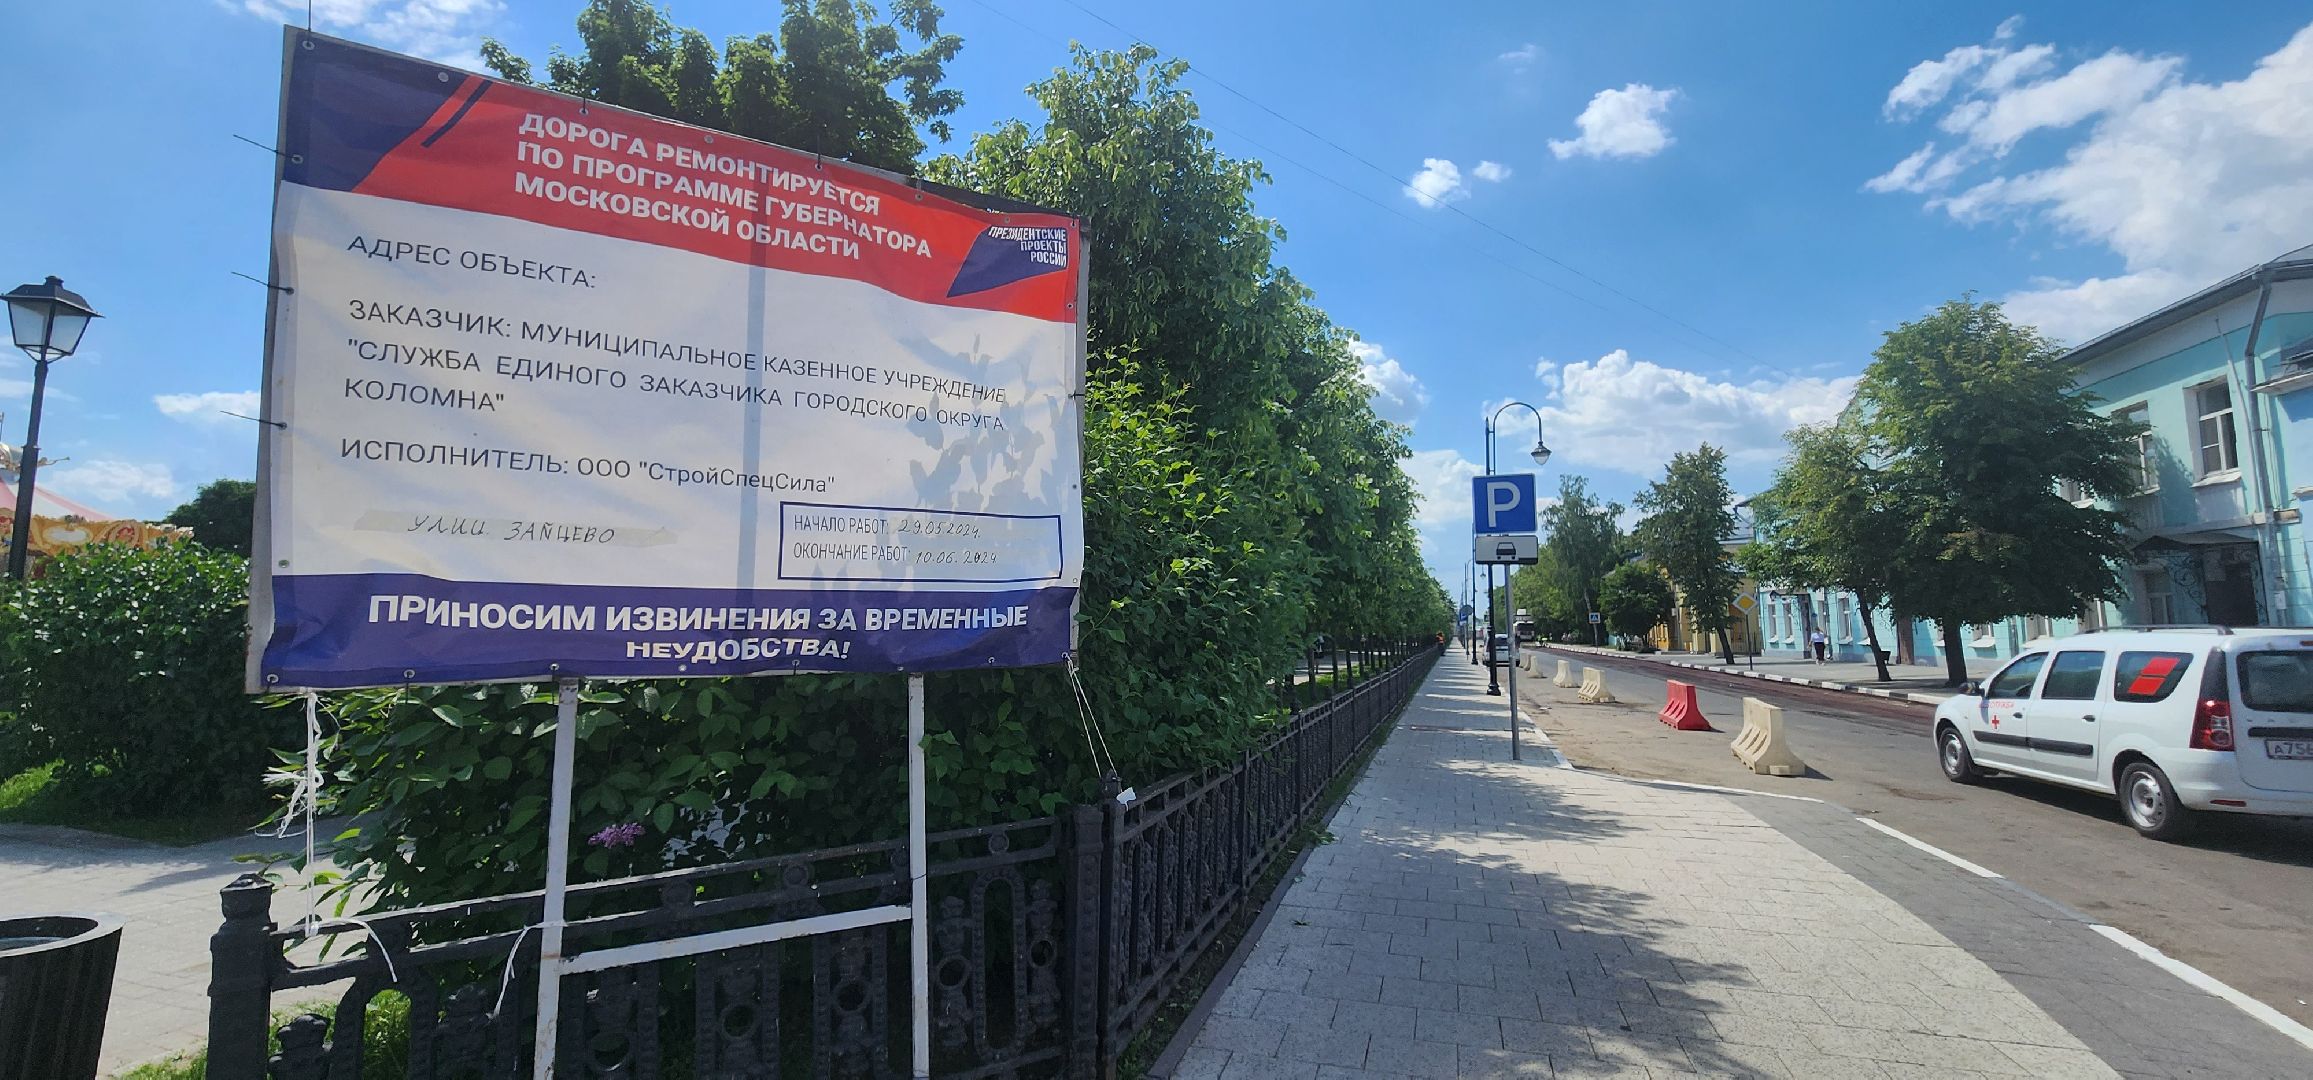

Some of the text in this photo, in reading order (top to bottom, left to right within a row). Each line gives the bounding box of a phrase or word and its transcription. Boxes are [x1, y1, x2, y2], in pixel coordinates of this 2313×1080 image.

[518, 112, 881, 216] ДОРОГА РЕМОНТИРУЕТСЯ
[514, 171, 860, 261] МОСКОВСКОЙ ОБЛАСТИ
[517, 140, 933, 259] ПО ПРОГРАММЕ ГУБЕРНАТОРА
[987, 225, 1067, 243] ПРЕЗИДЕНТСКИЕ
[1020, 240, 1067, 255] ПРОЕКТЫ
[347, 235, 597, 290] АДРЕС ОБЪЕКТА:
[1030, 251, 1067, 268] РОССИИ
[349, 299, 1007, 404] ЗАКАЗЧИК: МУНИЦИПАЛЬНОЕ КАЗЕННОЕ УЧРЕЖДЕНИЕ
[344, 377, 505, 412] КОЛОМНА"
[348, 338, 1005, 432] "СЛУЖБА ЕДИНОГО ЗАКАЗЧИКА ГОРОДСКОГО ОКРУГА
[340, 437, 836, 494] ИСПОЛНИТЕЛЬ: ООО "СтройСпецСила"
[793, 514, 846, 533] НАЧАЛО
[849, 517, 889, 536] РАБОТ:
[1486, 481, 1521, 528] P
[793, 542, 868, 562] ОКОНЧАНИЕ
[871, 545, 911, 563] РАБОТ:
[368, 594, 1029, 632] ПРИНОСИМ ИЗВИНЕНИЯ ЗА ВРЕМЕННЫЕ
[626, 637, 851, 664] НЕУДОБСТВА!
